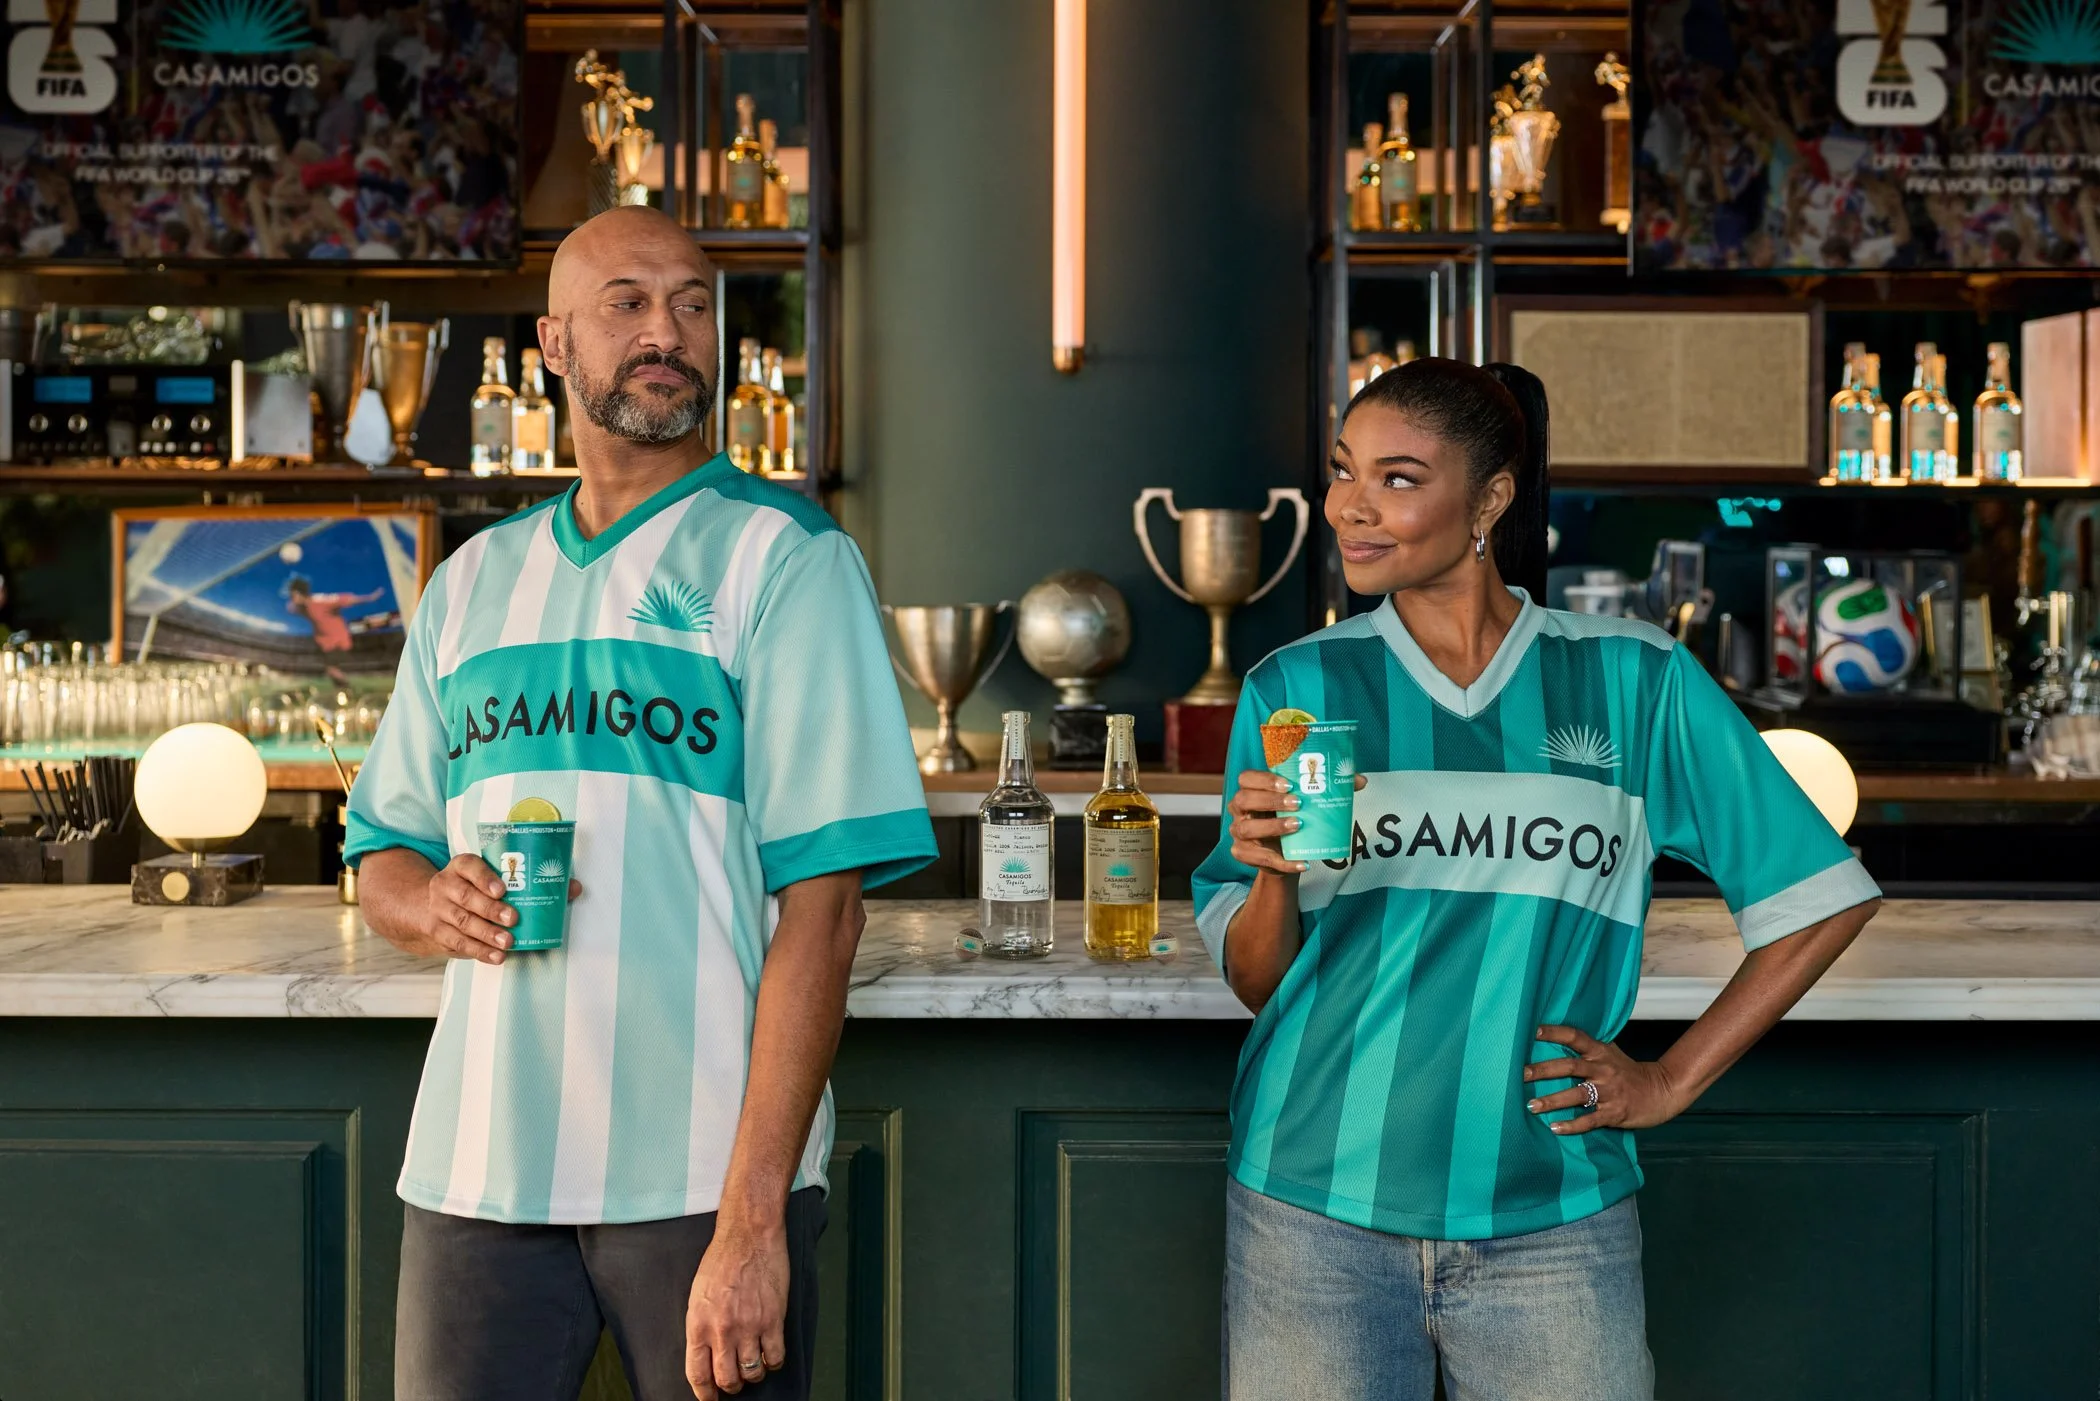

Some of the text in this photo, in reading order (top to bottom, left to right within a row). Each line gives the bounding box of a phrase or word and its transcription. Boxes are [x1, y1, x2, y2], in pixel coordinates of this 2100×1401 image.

[153, 63, 320, 88] CASAMIGOS
[36, 78, 87, 97] FIFA
[1866, 90, 1917, 108] FIFA
[248, 144, 281, 162] THE
[75, 165, 110, 182] FIFA
[113, 166, 175, 183] WORLD
[1904, 177, 1941, 193] FIFA
[1945, 177, 2010, 194] WORLD
[1322, 812, 1622, 878] ASAMIGOS
